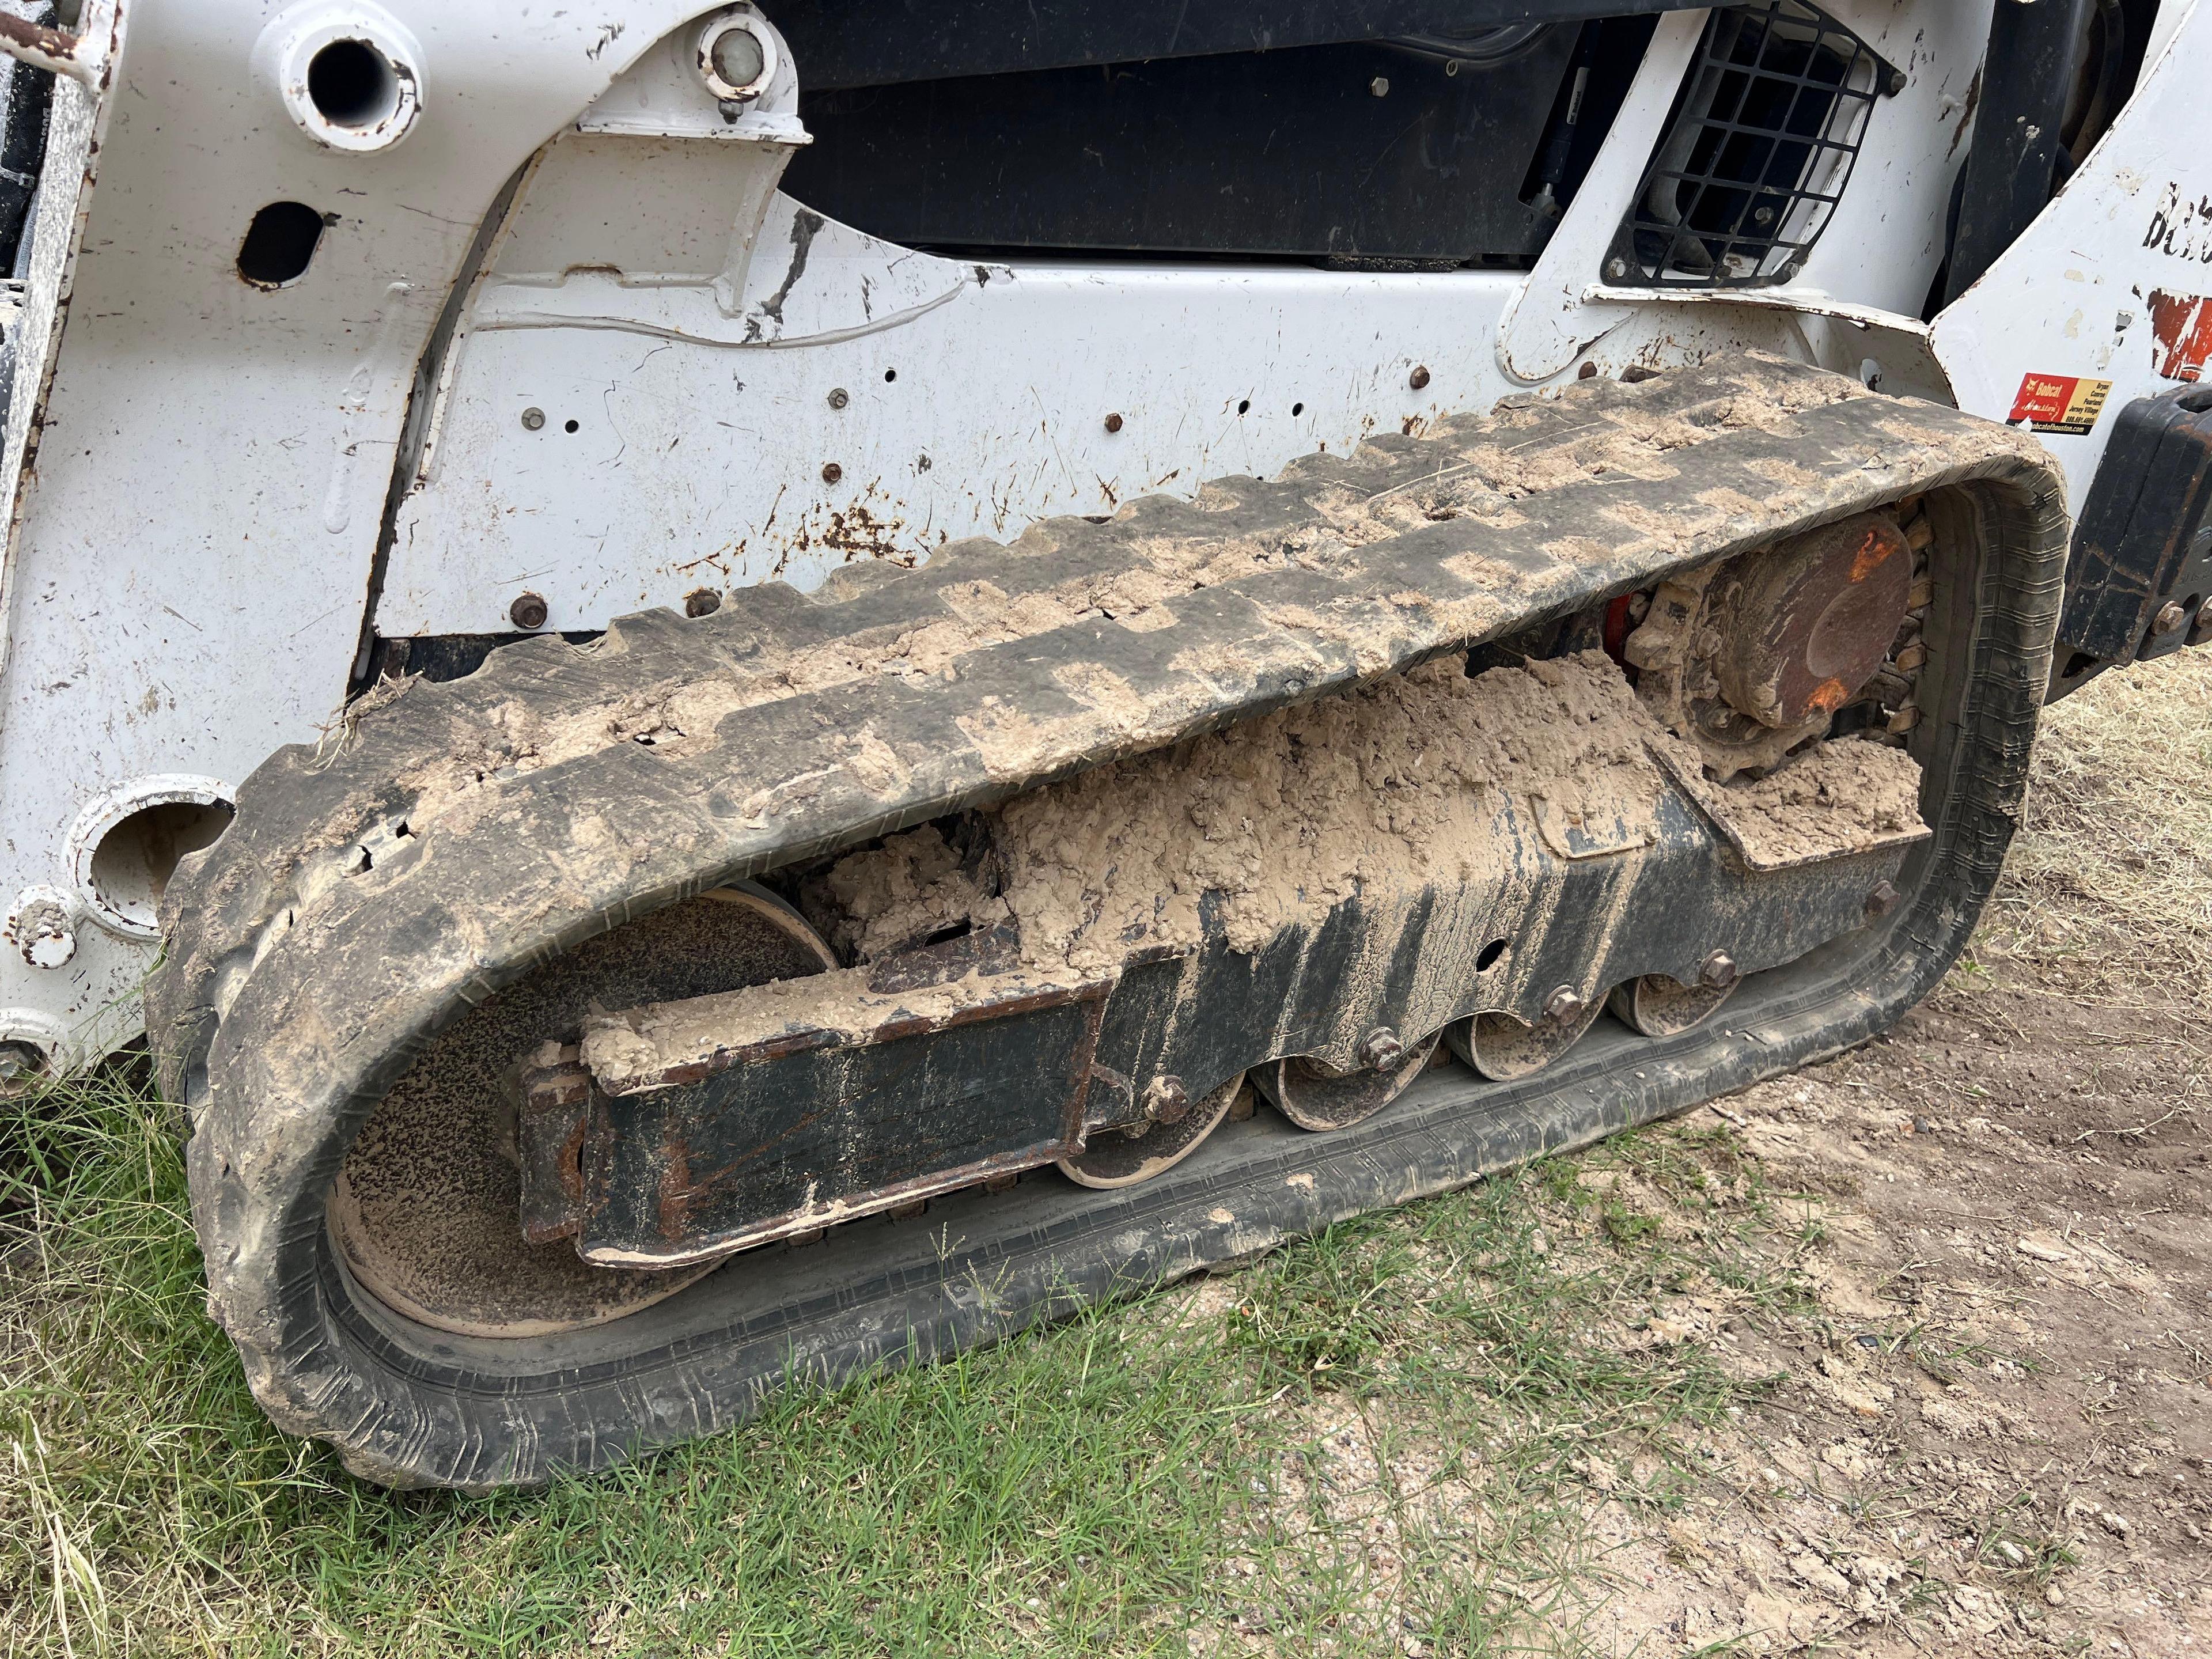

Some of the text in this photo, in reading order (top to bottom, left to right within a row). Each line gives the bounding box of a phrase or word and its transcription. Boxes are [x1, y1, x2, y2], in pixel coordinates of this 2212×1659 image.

[2035, 382, 2063, 398] Bobcat
[2096, 382, 2109, 391] Bryan
[2069, 406, 2099, 415] Jersey Village
